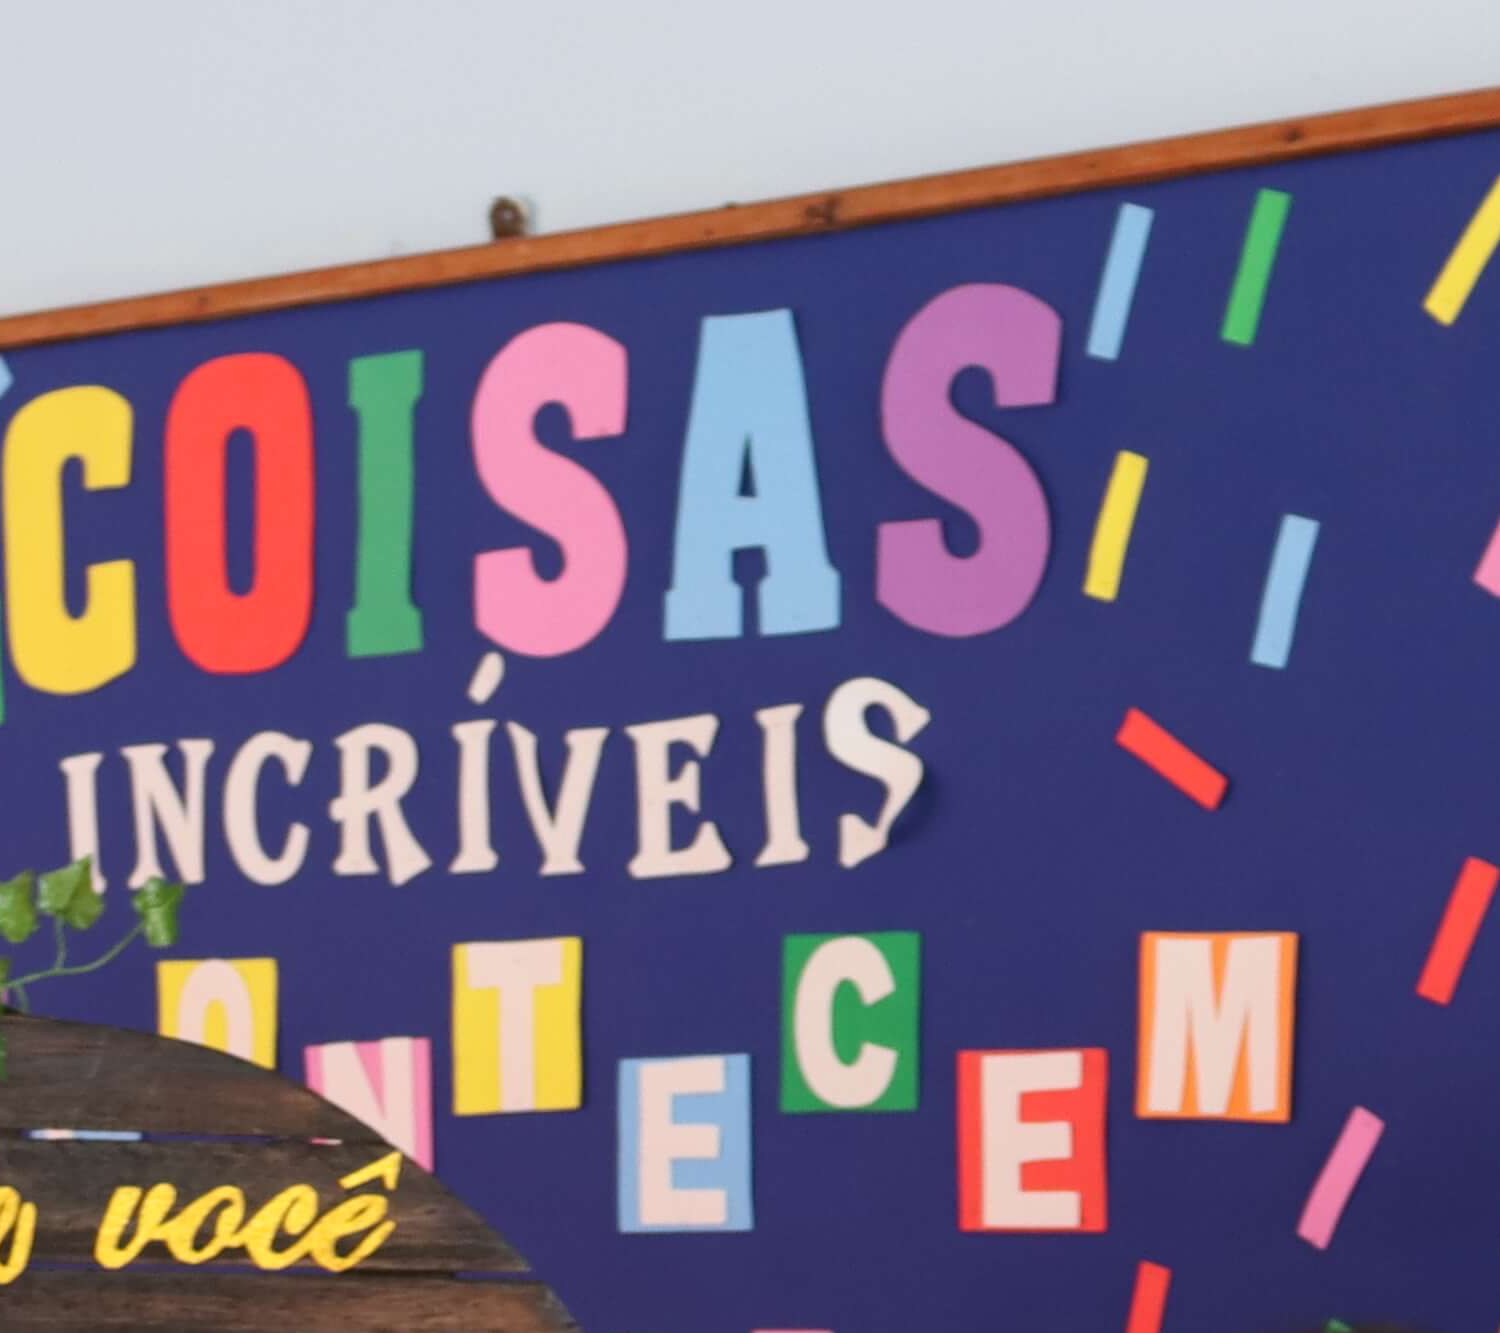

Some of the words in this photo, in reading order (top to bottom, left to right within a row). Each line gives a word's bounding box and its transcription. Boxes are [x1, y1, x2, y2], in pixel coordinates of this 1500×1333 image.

[1, 282, 1063, 696] COISAS
[61, 652, 931, 895] INCRÍVEIS
[94, 1150, 404, 1271] você
[177, 935, 1282, 1228] ONTECEM
